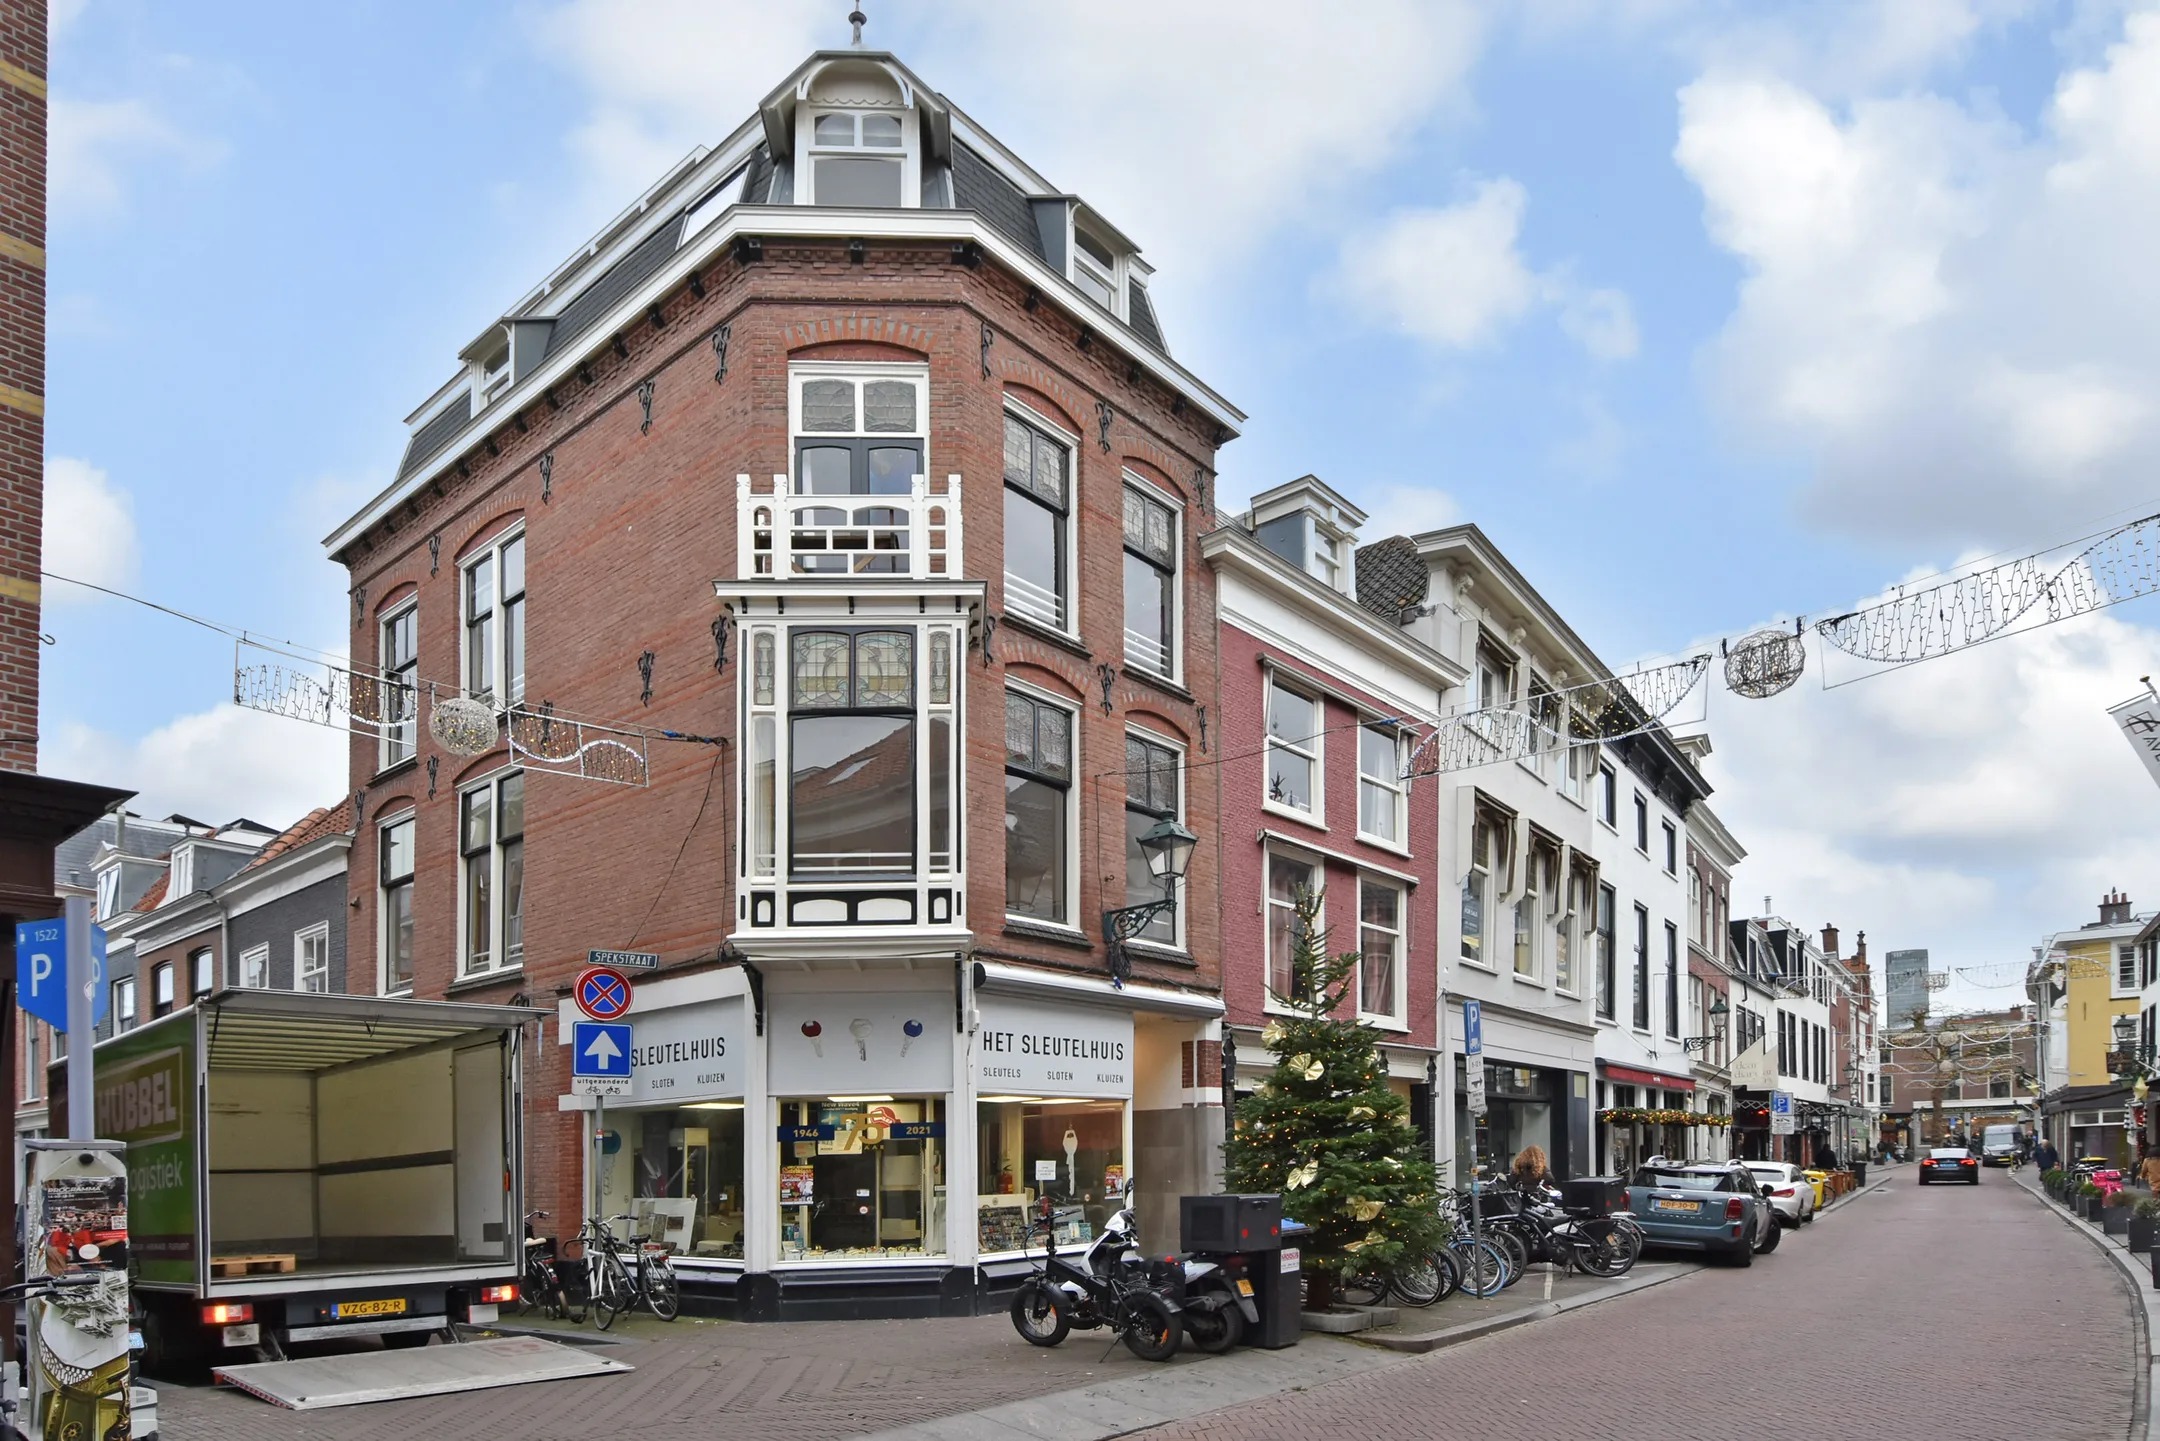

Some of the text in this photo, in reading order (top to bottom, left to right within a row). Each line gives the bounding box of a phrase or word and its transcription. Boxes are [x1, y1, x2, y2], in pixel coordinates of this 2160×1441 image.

[34, 929, 58, 942] 1522
[594, 951, 652, 967] SPEKSTRAAT
[31, 953, 52, 997] P
[1469, 1005, 1478, 1033] P
[631, 1036, 725, 1067] SLEUTELHUIS
[983, 1031, 1124, 1061] HET SLEUTELHUIS
[577, 1077, 629, 1086] uitgezonderd
[651, 1073, 725, 1089] SLOTEN KLUIZEN
[983, 1067, 1124, 1084] SLEUTELS SLOTEN KLUIZEN
[96, 1069, 177, 1135] HUBBEL
[793, 1128, 819, 1138] 1946
[840, 1113, 884, 1151] 75
[906, 1125, 931, 1135] 2021
[128, 1153, 184, 1200] ogistiek
[342, 1300, 402, 1315] VZG-82-R
